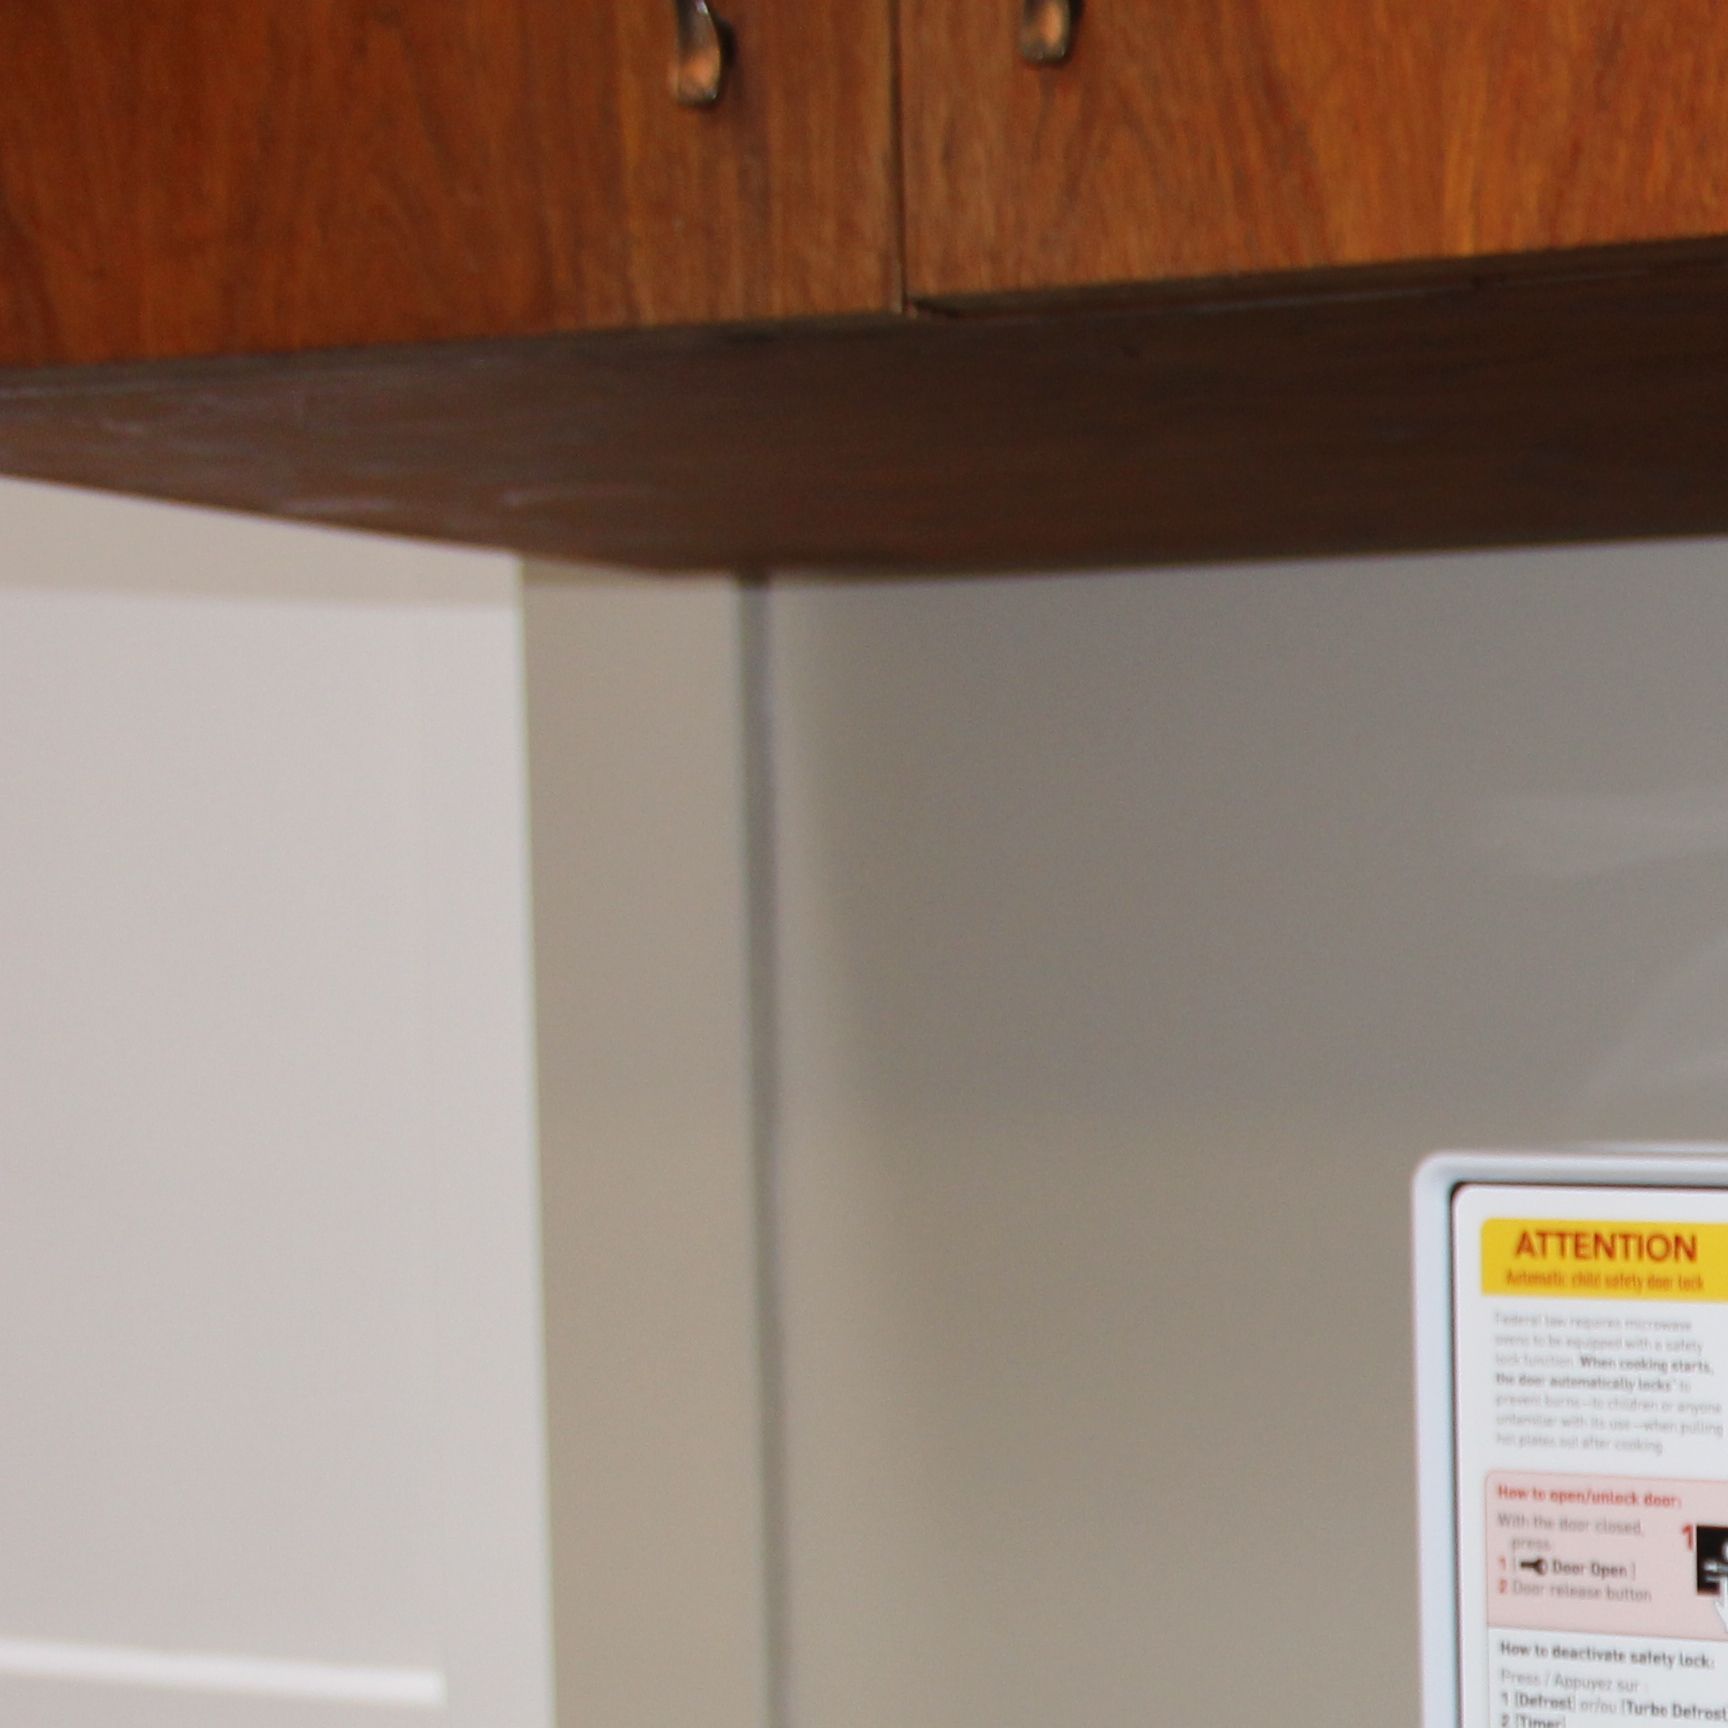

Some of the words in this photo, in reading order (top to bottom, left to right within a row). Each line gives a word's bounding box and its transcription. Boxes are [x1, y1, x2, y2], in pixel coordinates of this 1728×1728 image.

[1515, 1232, 1697, 1261] ATTENTION
[1498, 1485, 1528, 1499] How
[1533, 1487, 1546, 1500] to
[1550, 1490, 1638, 1506] open/unlock
[1681, 1525, 1694, 1551] 1
[1553, 1560, 1585, 1574] Door
[1592, 1562, 1628, 1580] Open
[1501, 1643, 1529, 1656] How
[1535, 1645, 1547, 1657] to
[1552, 1646, 1625, 1662] deactivate
[1630, 1651, 1675, 1669] safety
